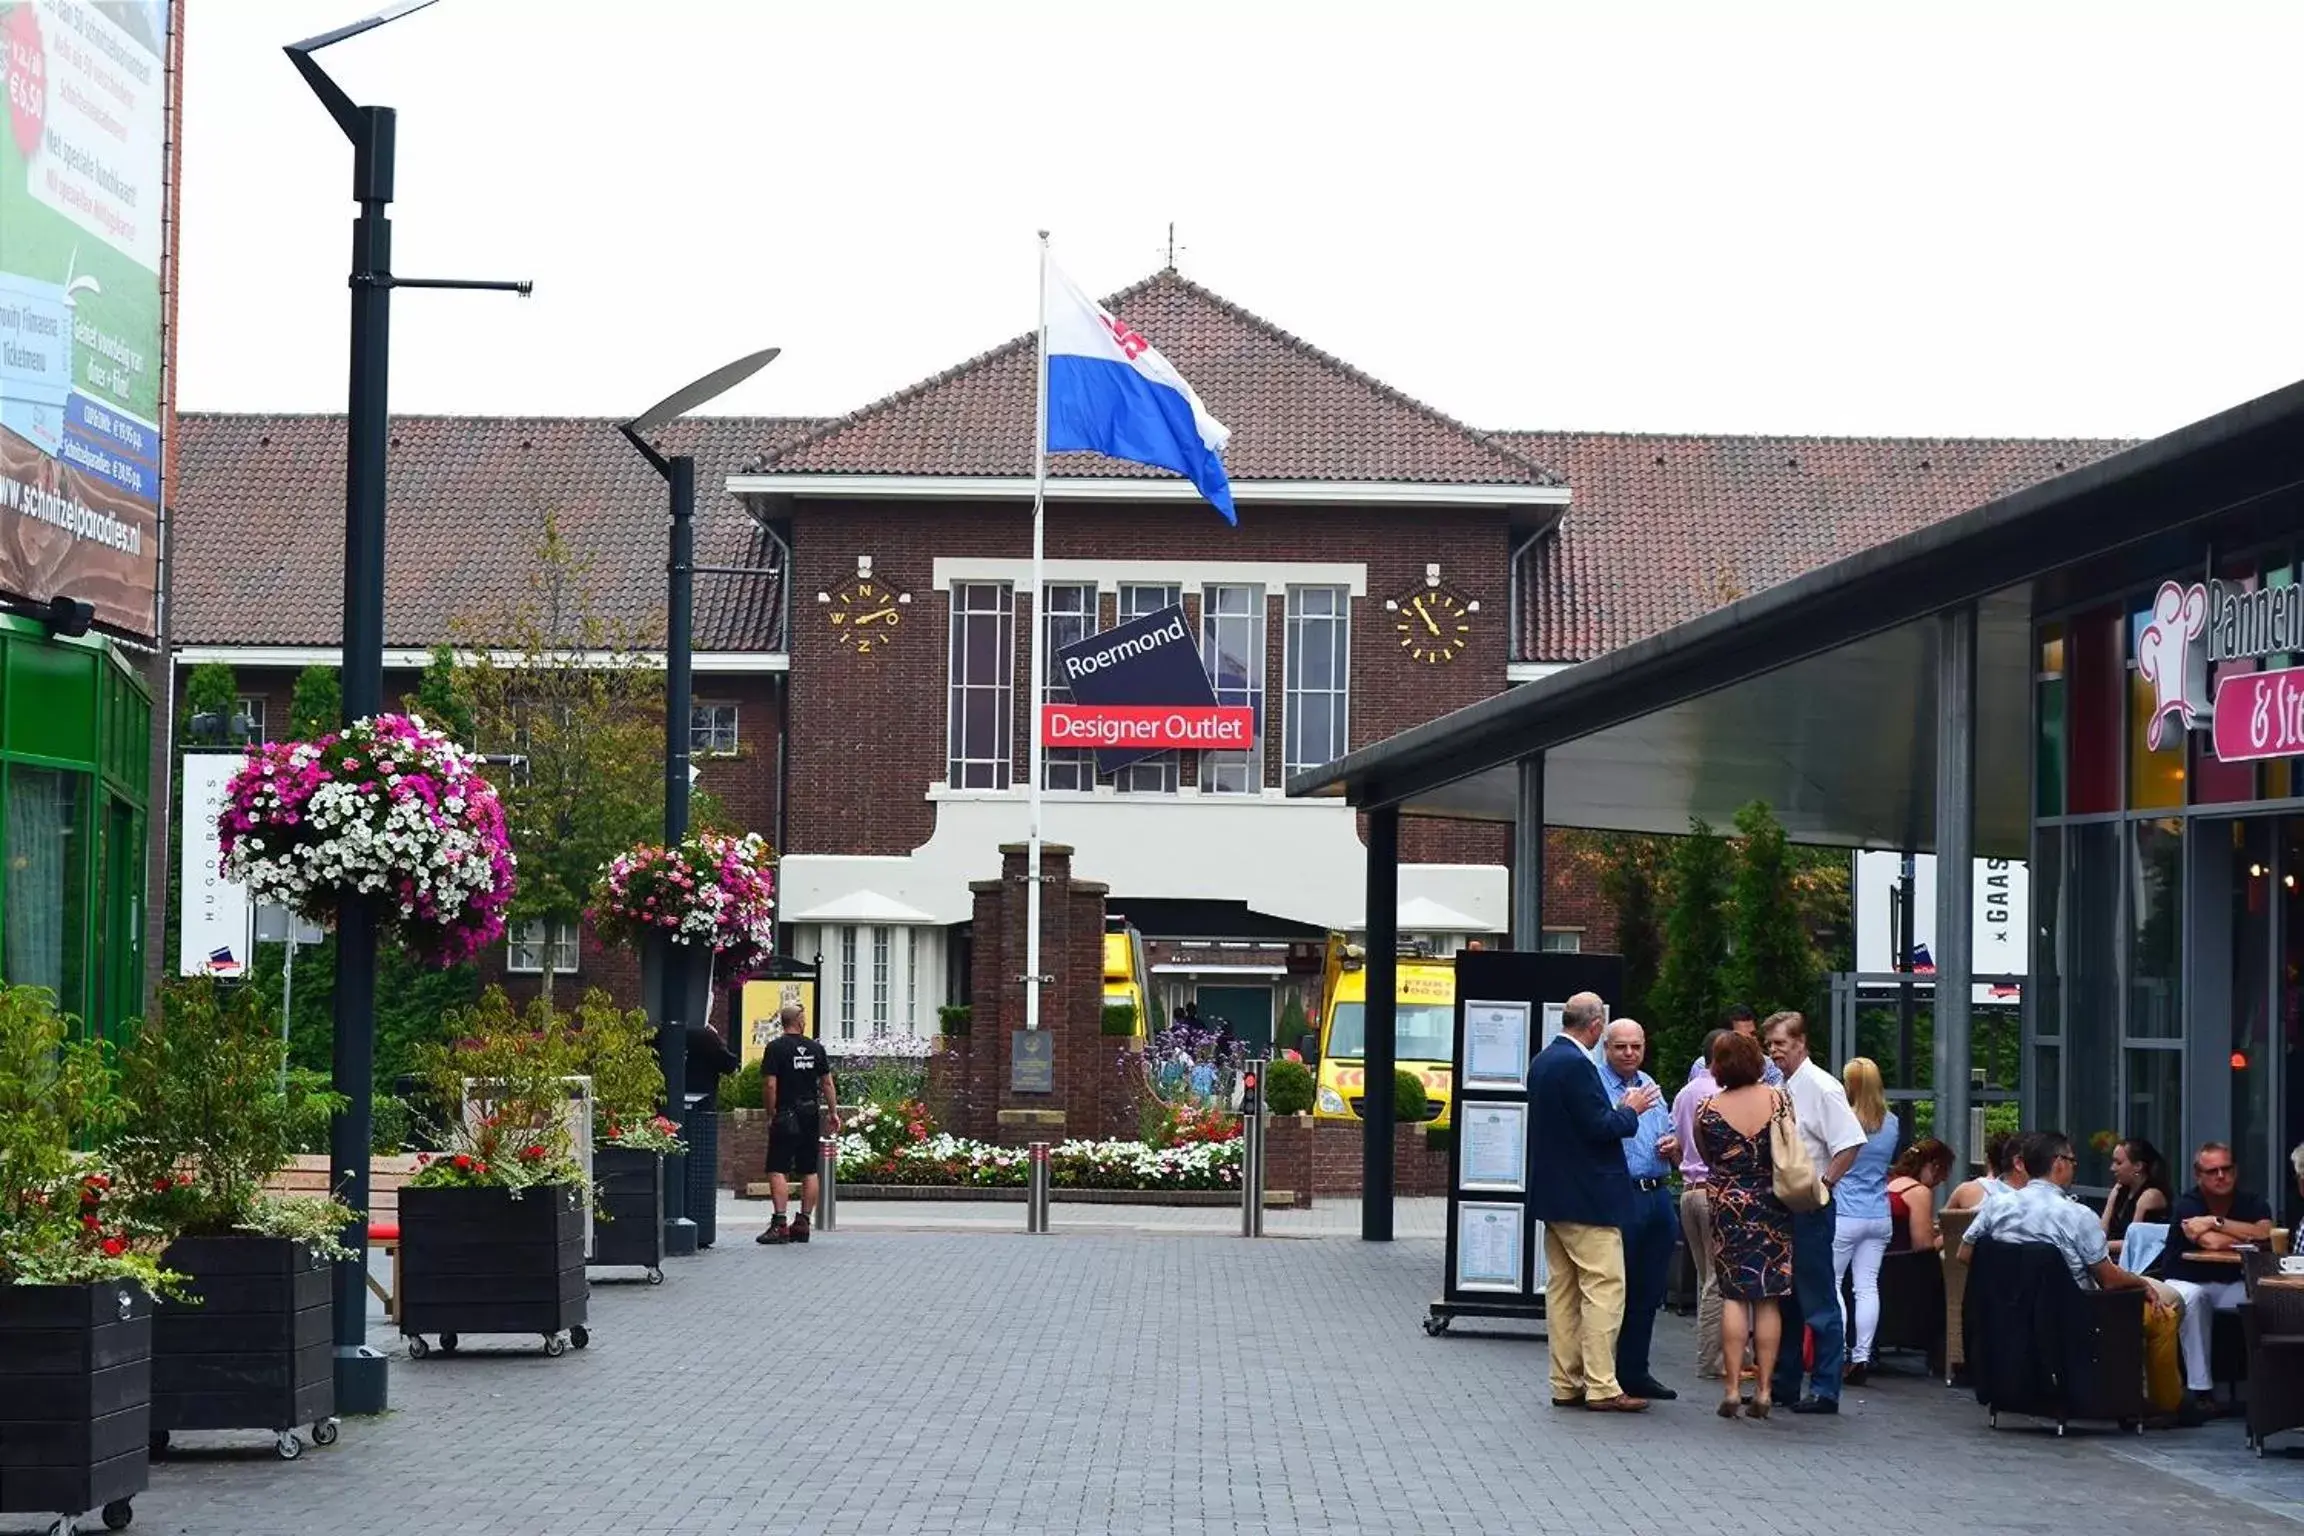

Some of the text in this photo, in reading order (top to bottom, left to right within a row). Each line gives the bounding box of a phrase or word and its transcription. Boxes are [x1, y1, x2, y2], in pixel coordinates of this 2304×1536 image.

[829, 612, 845, 625] W
[860, 584, 872, 597] N
[2207, 578, 2304, 662] Pannen
[1065, 615, 1186, 680] Roermond
[1051, 713, 1243, 745] Designer Outlet
[2250, 679, 2273, 749] &
[205, 778, 217, 921] HUGO BOSS
